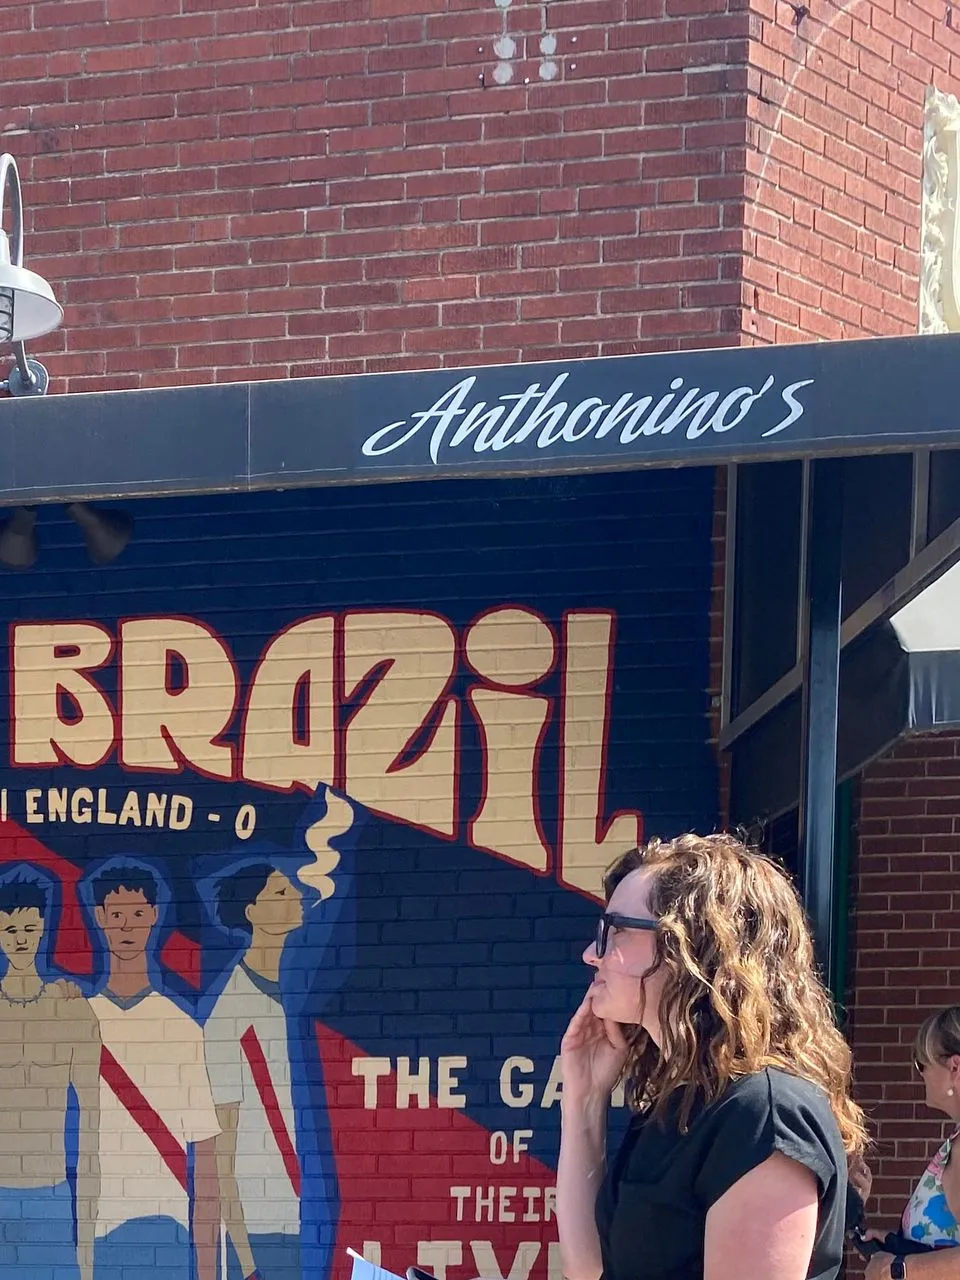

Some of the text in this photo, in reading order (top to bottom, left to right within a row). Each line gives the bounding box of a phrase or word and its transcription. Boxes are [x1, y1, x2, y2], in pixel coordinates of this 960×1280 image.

[361, 372, 814, 465] Anthonino's
[25, 787, 194, 831] ENGLAND
[351, 1056, 468, 1109] THE
[489, 1129, 534, 1165] OF
[450, 1186, 558, 1223] THEIR
